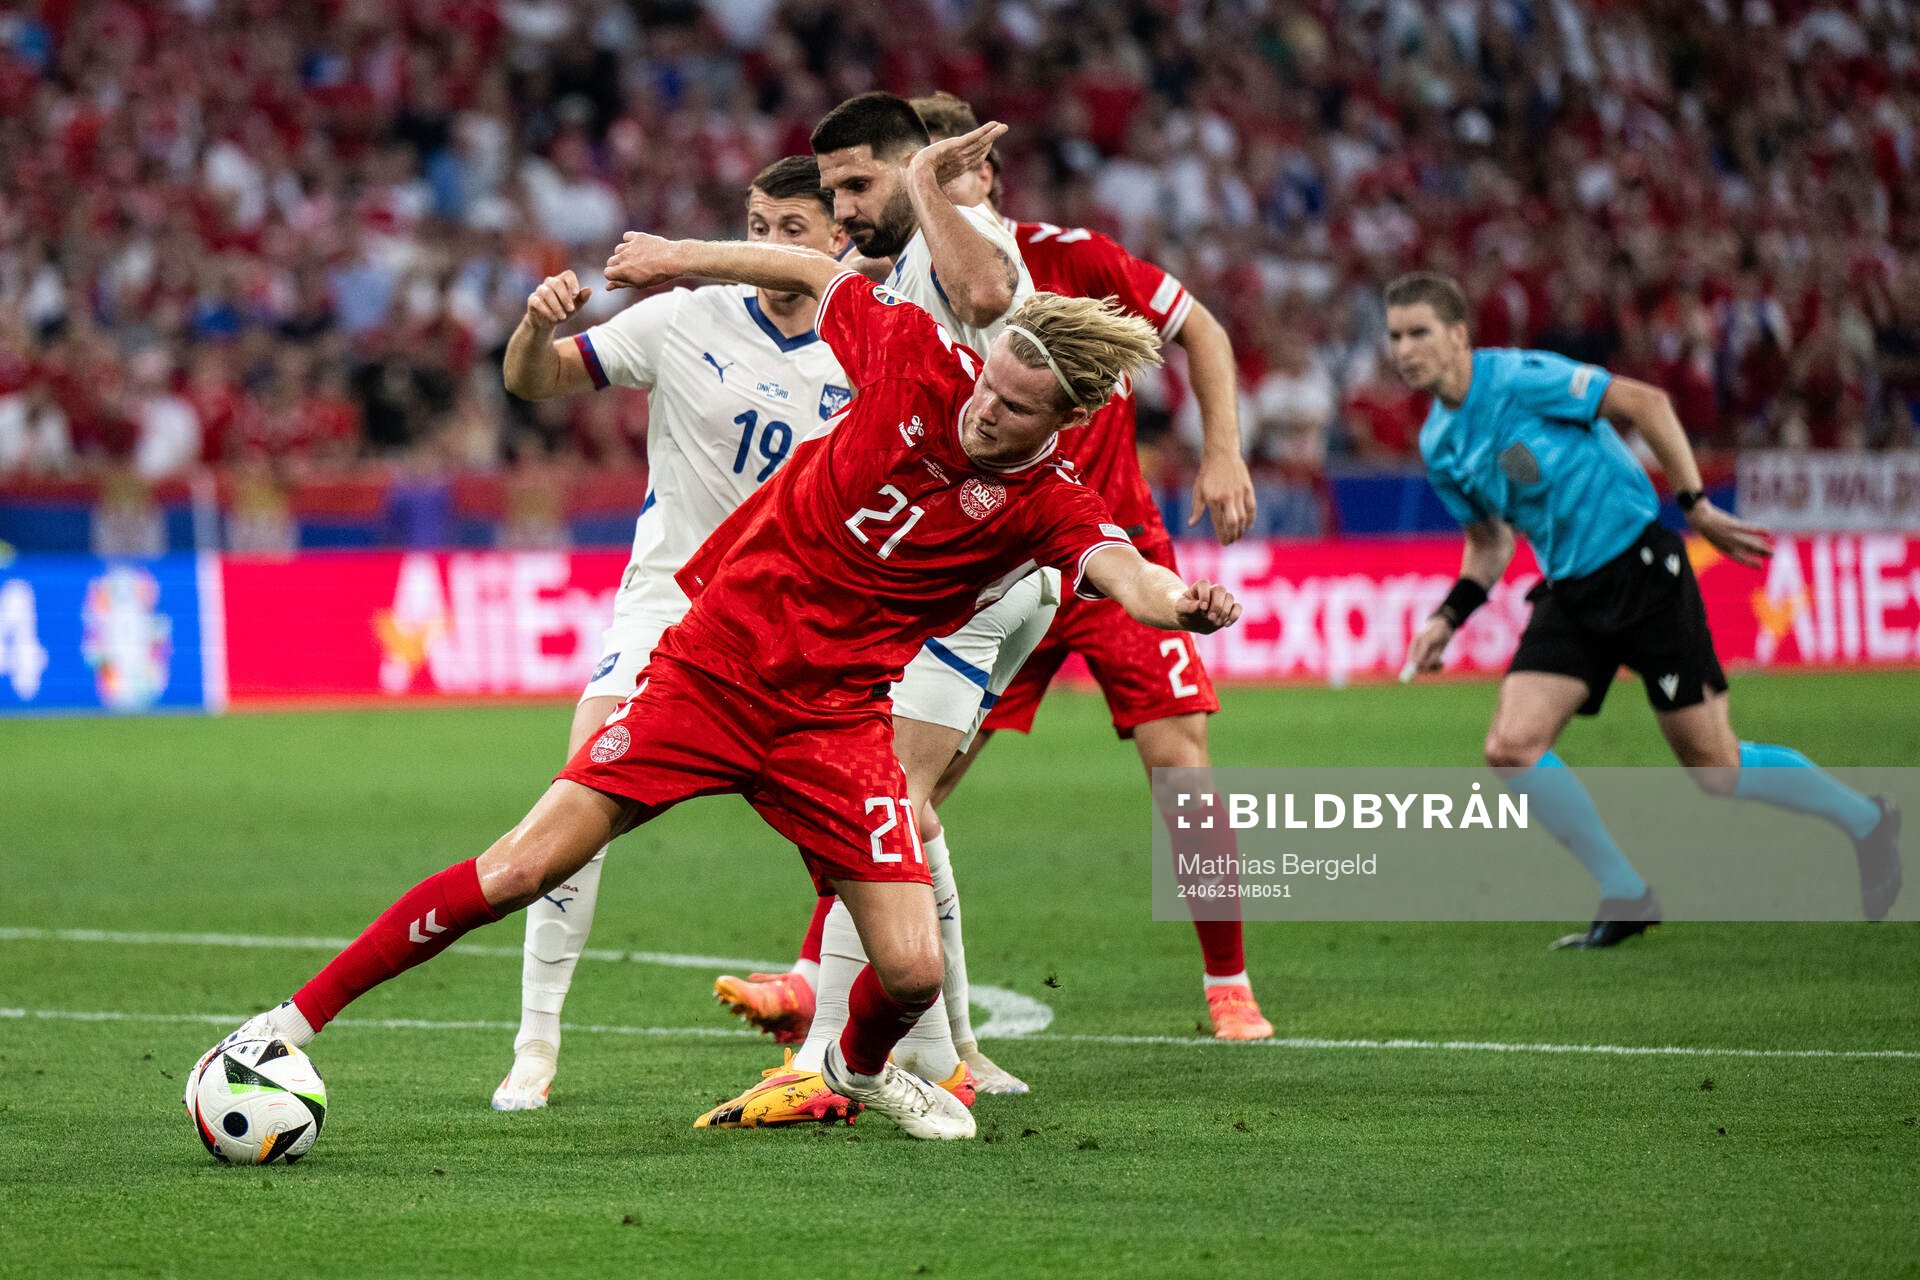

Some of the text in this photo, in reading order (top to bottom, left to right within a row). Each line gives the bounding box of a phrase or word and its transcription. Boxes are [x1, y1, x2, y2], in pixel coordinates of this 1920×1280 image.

[733, 409, 792, 483] 19
[845, 484, 925, 560] 21
[970, 484, 997, 510] DBU
[1755, 533, 1920, 664] AliE
[1159, 637, 1199, 699] 2
[865, 796, 923, 864] 21
